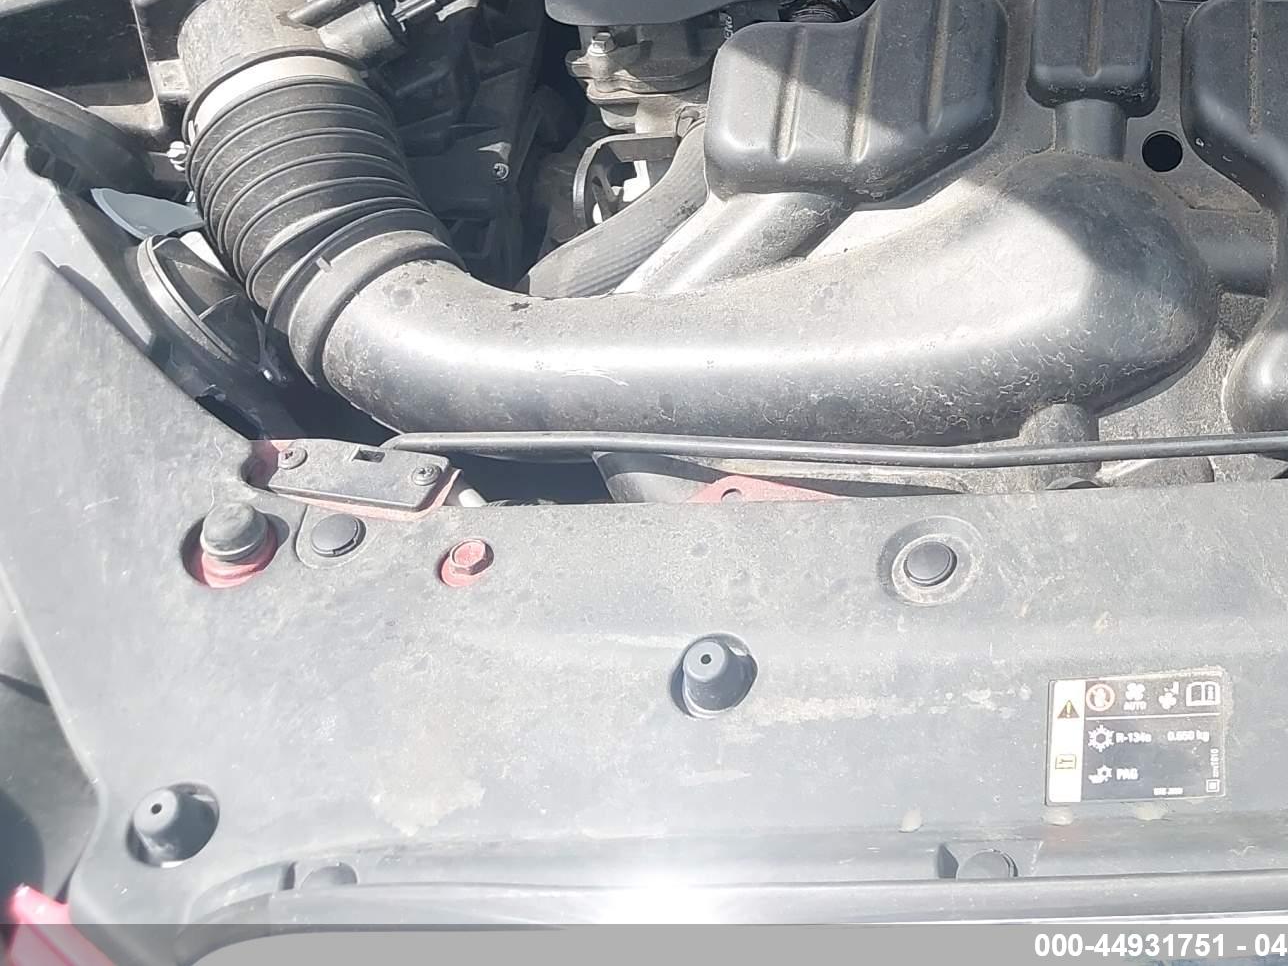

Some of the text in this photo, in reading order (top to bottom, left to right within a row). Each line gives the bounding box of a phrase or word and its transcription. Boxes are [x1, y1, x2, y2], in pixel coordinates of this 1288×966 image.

[1123, 701, 1147, 711] AUTO
[1115, 731, 1152, 743] R-134a
[1116, 767, 1139, 781] PAG
